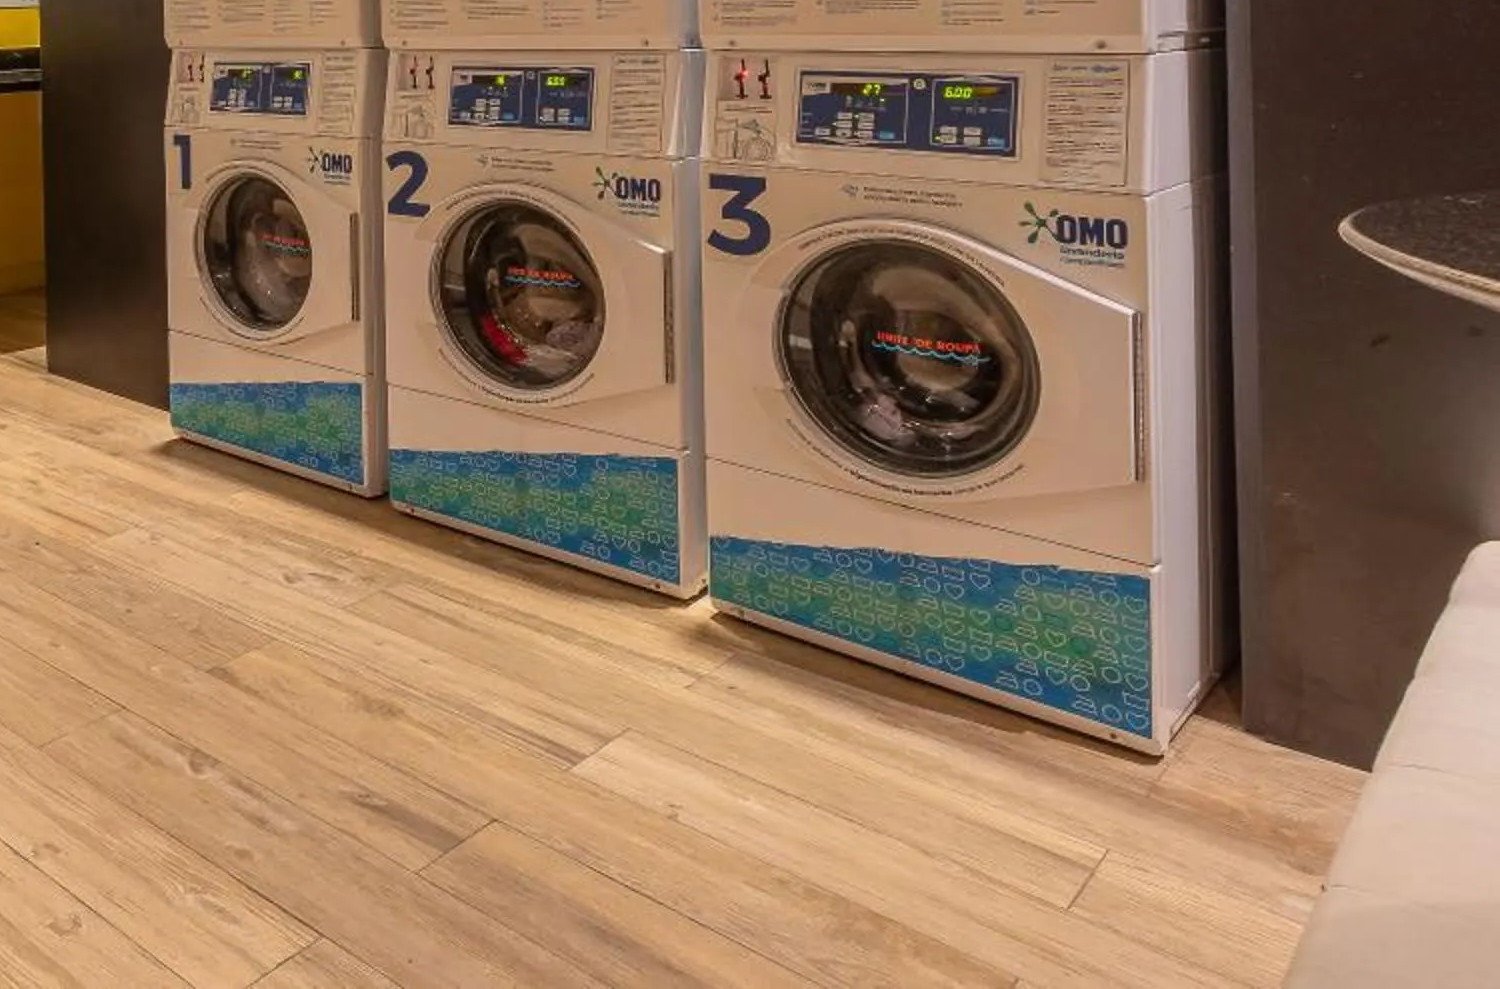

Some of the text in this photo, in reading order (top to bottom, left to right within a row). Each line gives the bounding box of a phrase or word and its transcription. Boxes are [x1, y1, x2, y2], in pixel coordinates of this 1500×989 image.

[174, 133, 191, 189] 1
[321, 153, 353, 174] OMO
[386, 150, 430, 217] 2
[614, 176, 662, 203] OMO
[708, 174, 771, 256] 3
[1055, 214, 1129, 250] OMO
